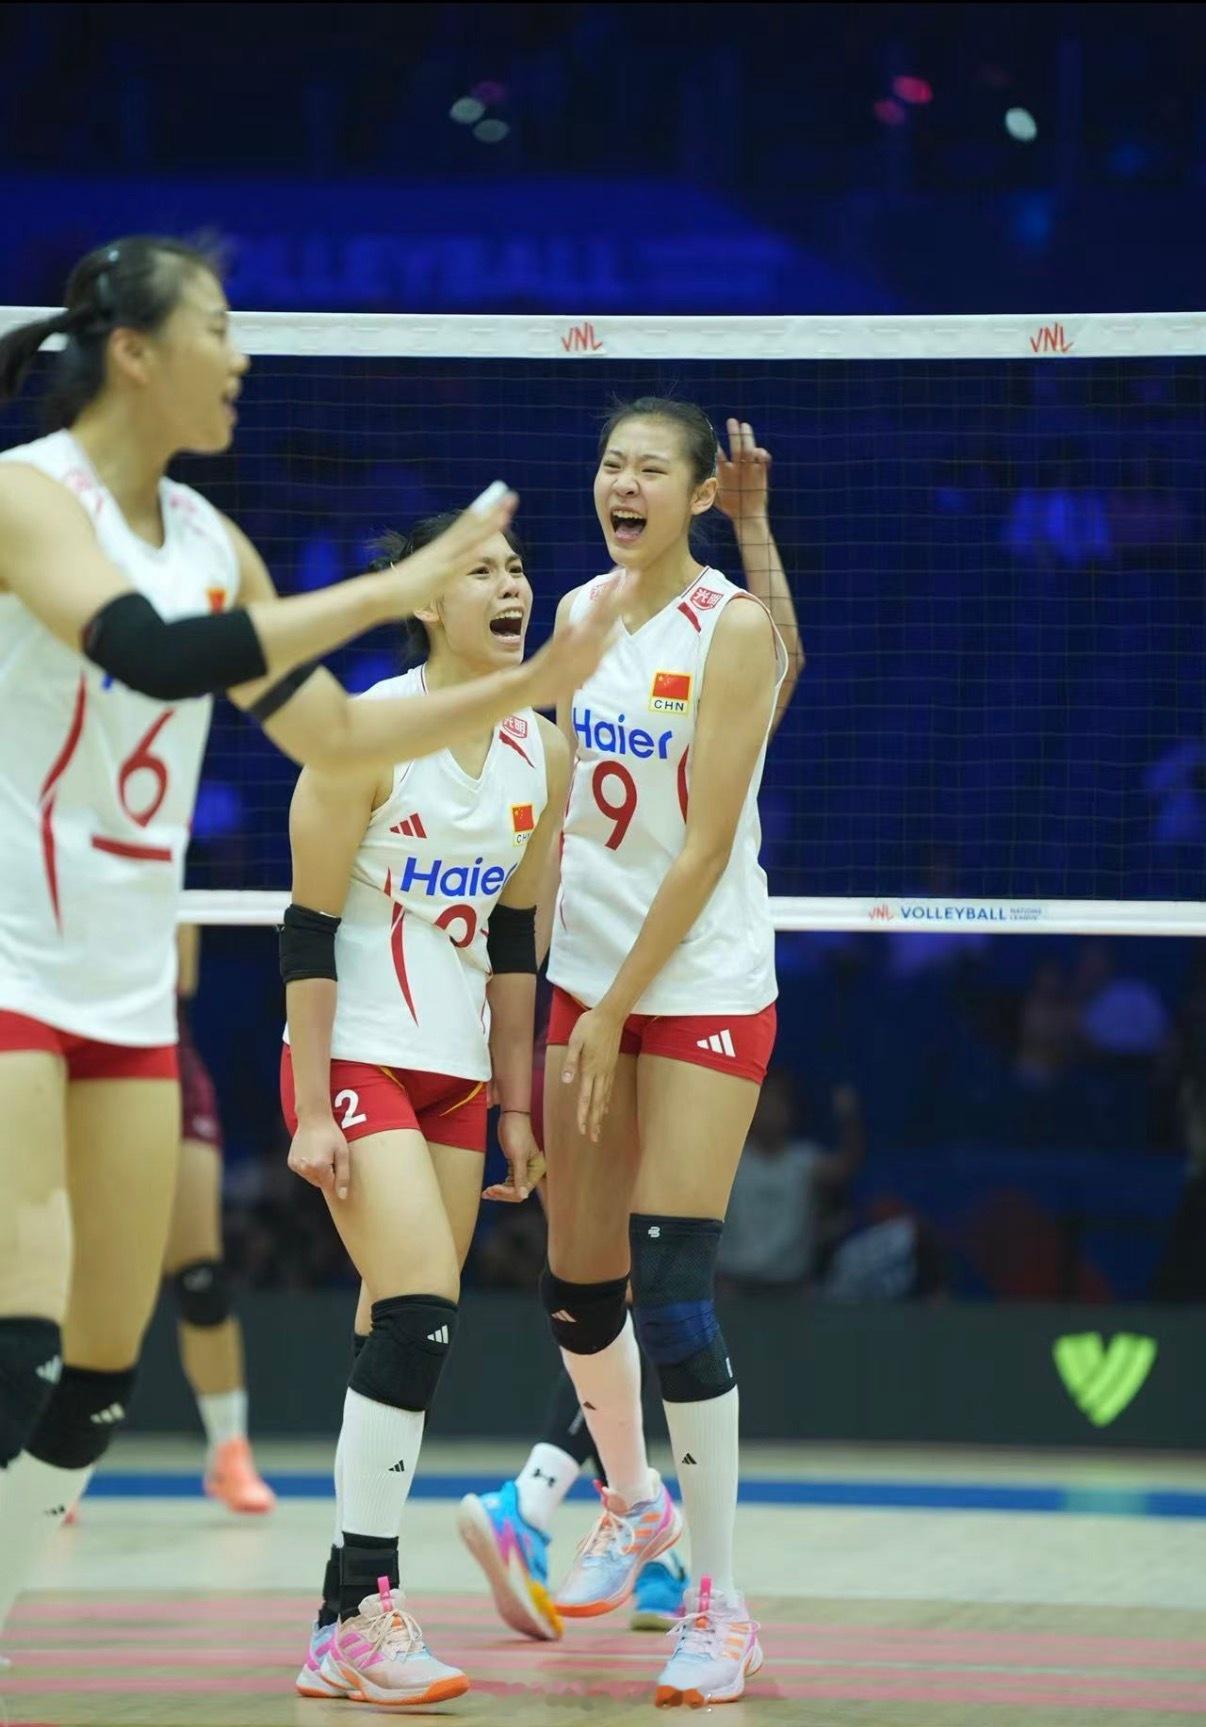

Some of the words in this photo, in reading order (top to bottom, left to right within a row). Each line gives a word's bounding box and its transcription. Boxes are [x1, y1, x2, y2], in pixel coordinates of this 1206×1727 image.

[561, 321, 603, 352] VNL
[1029, 321, 1075, 353] VNL
[653, 699, 685, 711] CHN
[573, 706, 673, 759] Haier
[119, 707, 176, 829] 6
[592, 760, 638, 851] 9
[901, 906, 1006, 921] VOLLEYBALL
[334, 1089, 368, 1129] 2
